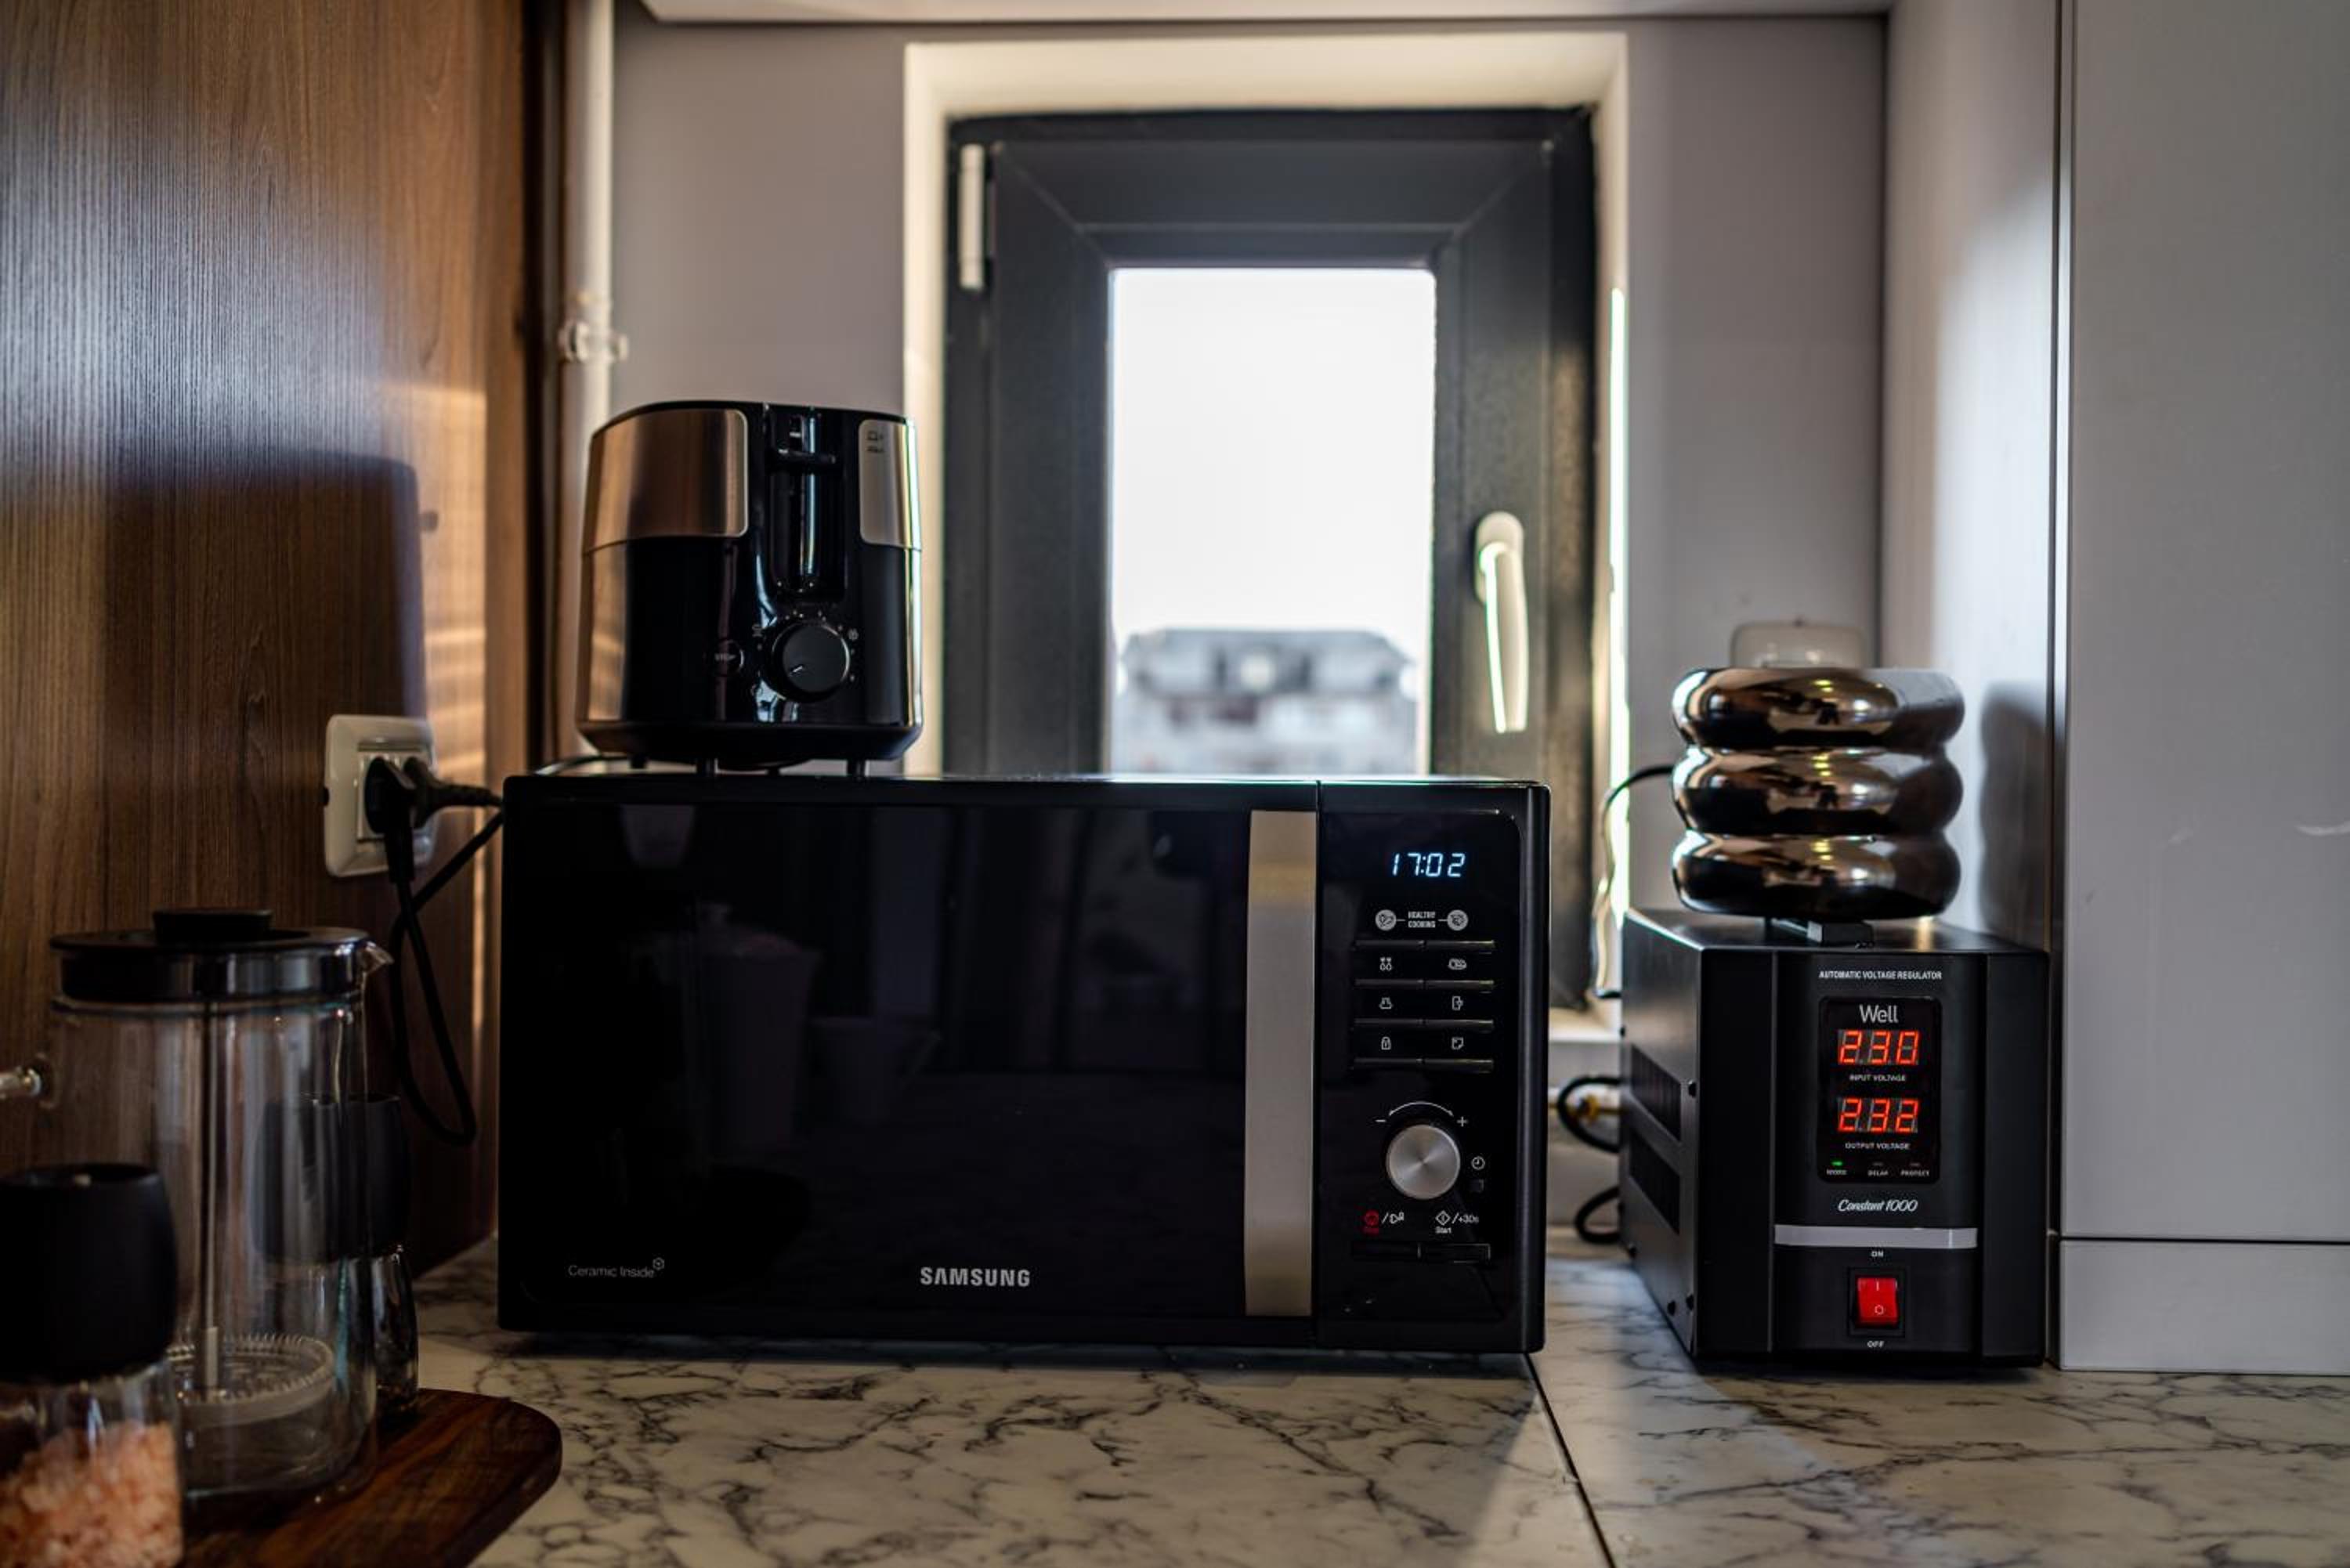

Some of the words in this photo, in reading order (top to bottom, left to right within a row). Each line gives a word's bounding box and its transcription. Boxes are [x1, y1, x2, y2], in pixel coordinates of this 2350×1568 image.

[1392, 852, 1466, 878] 17:02
[1859, 1003, 1899, 1023] Well
[1838, 1030, 1919, 1064] 230
[1838, 1097, 1919, 1132] 232
[1838, 1199, 1885, 1212] Constant
[1885, 1199, 1918, 1212] 1000
[568, 1264, 617, 1277] Ceramic
[920, 1266, 1031, 1287] SAMSUNG
